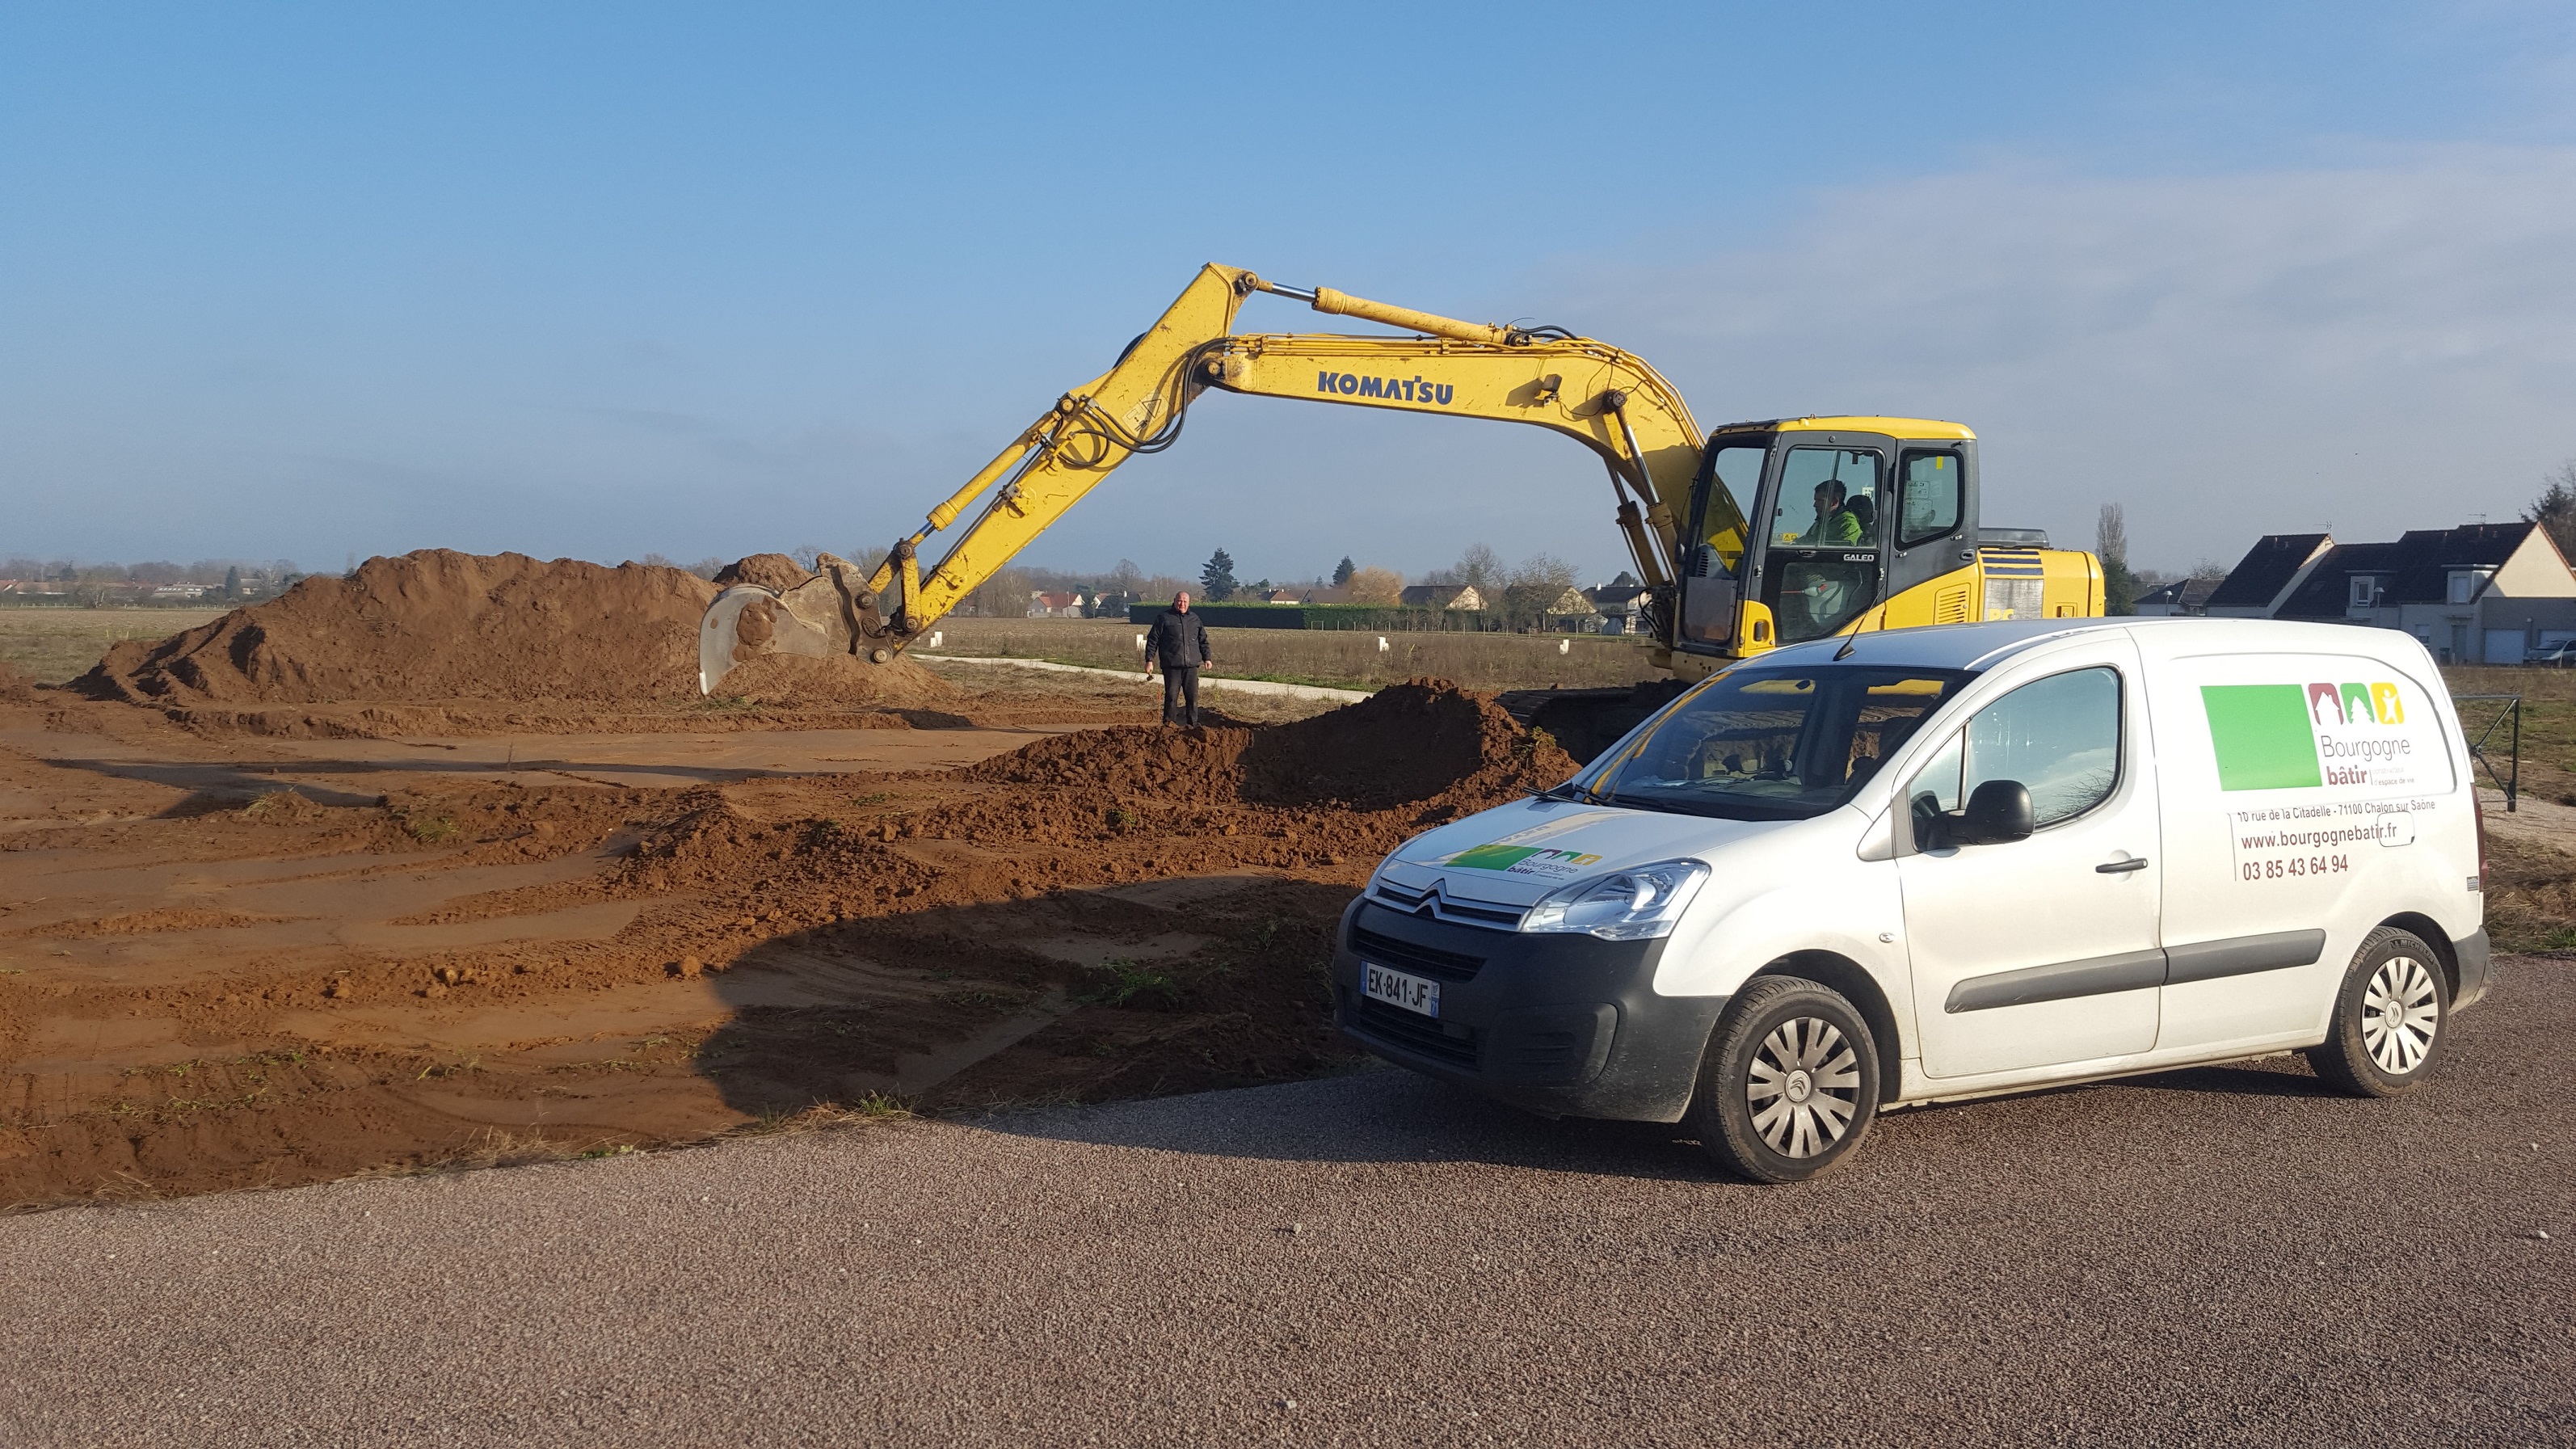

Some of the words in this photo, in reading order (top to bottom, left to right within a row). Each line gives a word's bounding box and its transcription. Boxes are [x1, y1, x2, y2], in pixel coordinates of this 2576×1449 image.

[1318, 371, 1454, 405] KOMATSU
[1843, 554, 1875, 562] GALEO
[2321, 735, 2411, 761] Bourgogne
[2326, 765, 2368, 786] bâtir
[2237, 811, 2249, 822] 10
[2252, 812, 2267, 821] rue
[2269, 809, 2280, 820] de
[2282, 808, 2291, 819] la
[2293, 805, 2331, 819] Citadelle
[2338, 803, 2363, 815] 71100
[2365, 801, 2394, 813] Chalon
[2396, 802, 2409, 811] sur
[2411, 798, 2435, 811] Saône
[2241, 823, 2397, 849] www.bourgognebatir.fr
[1507, 866, 1535, 874] bâtir
[1518, 858, 1578, 873] Bourgogne
[2243, 861, 2261, 880] 03
[2267, 860, 2283, 878] 85
[2288, 857, 2305, 876] 43
[2310, 856, 2327, 874] 64
[2331, 854, 2348, 873] 94
